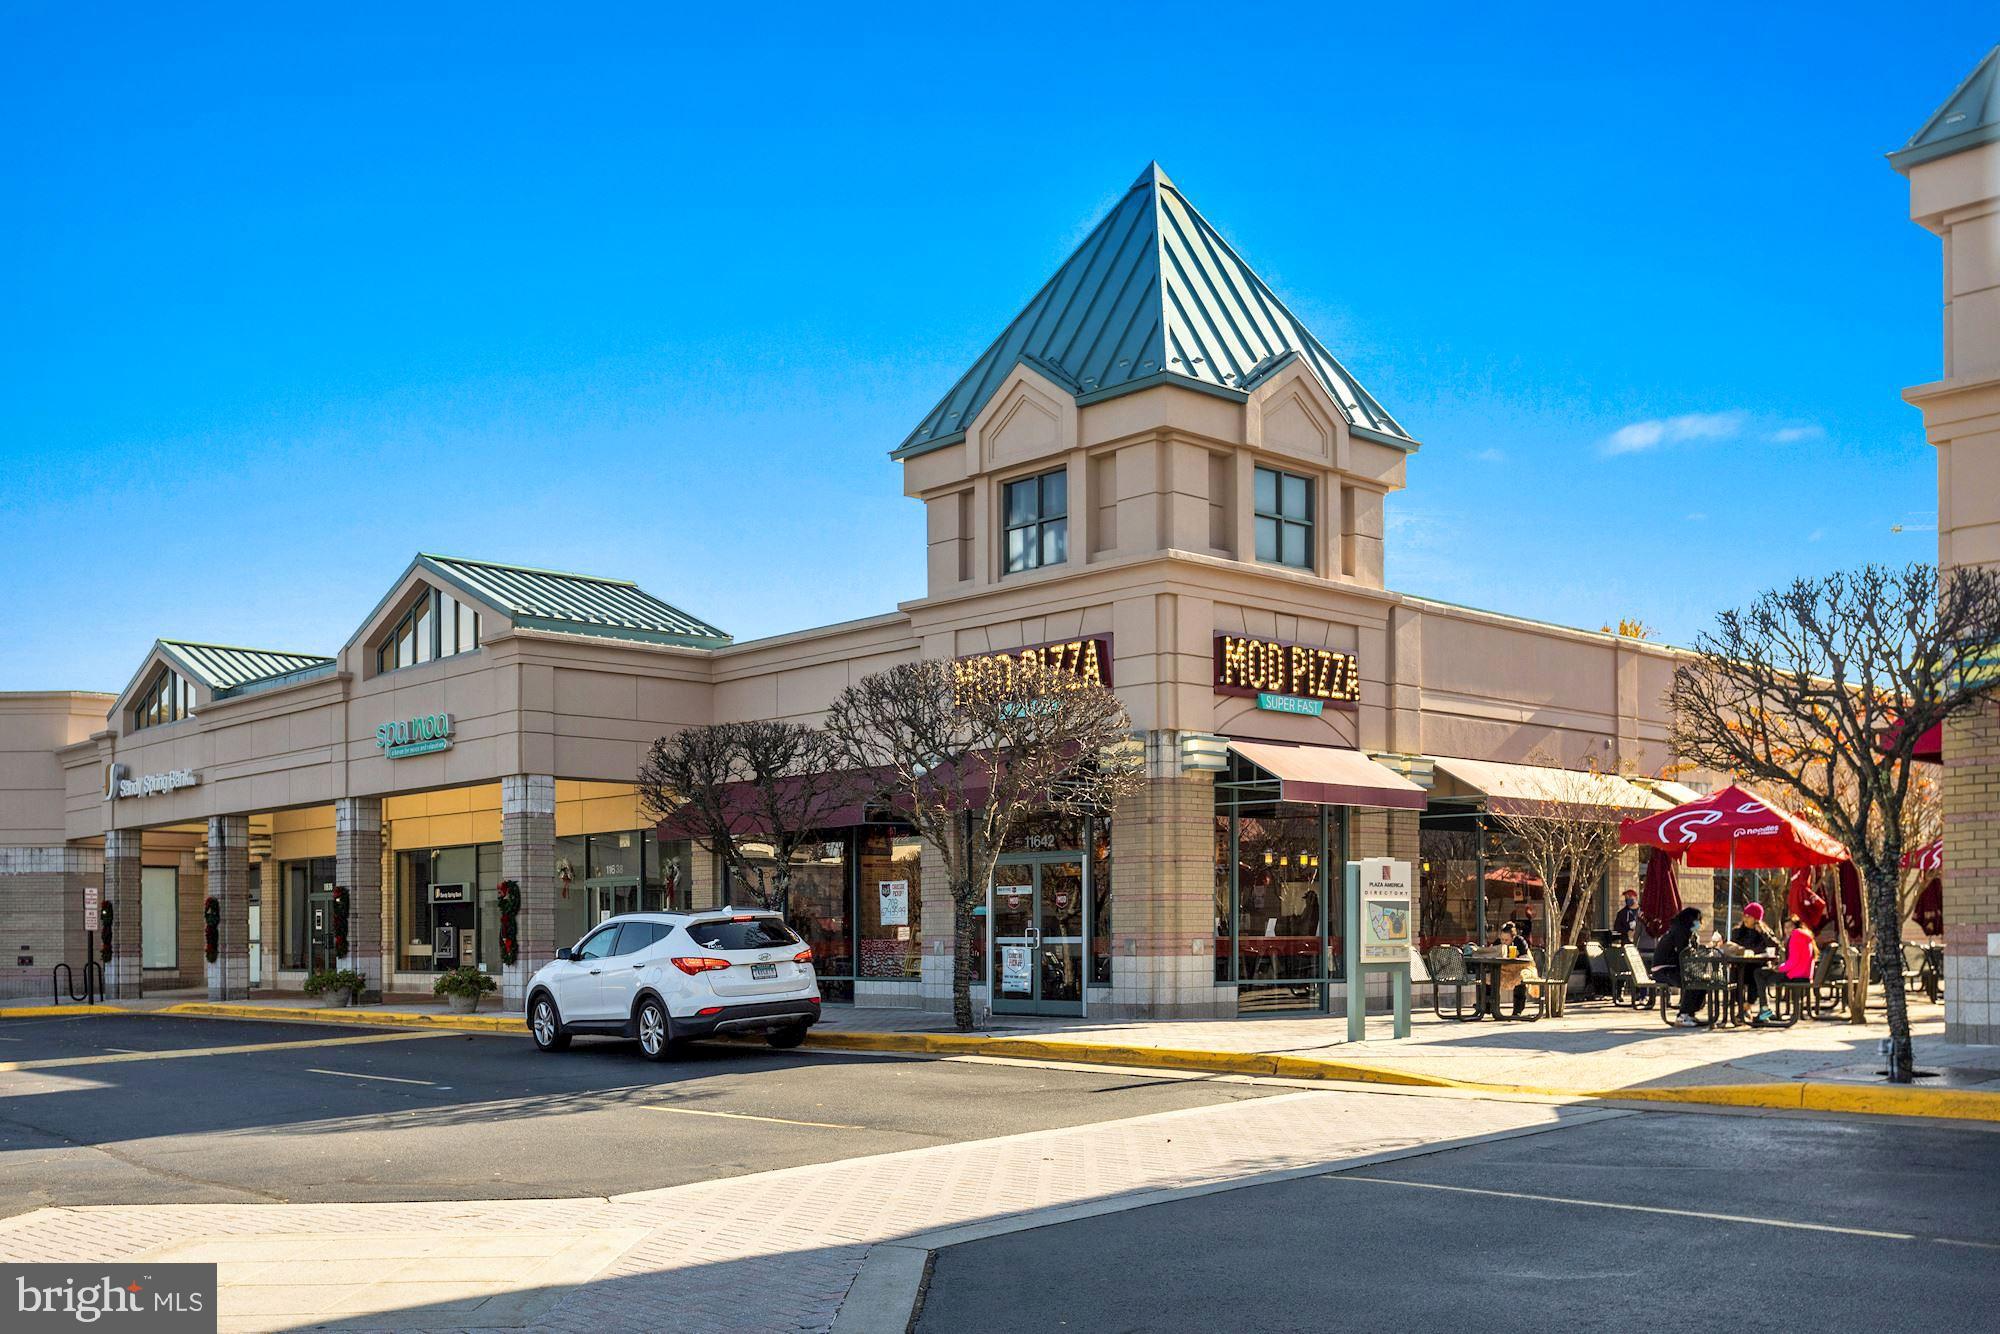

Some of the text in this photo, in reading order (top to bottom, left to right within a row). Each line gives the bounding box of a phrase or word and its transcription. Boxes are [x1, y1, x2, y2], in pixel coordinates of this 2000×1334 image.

[1021, 639, 1101, 697] PIZZA
[1225, 636, 1361, 702] MOD PIZZA
[1265, 696, 1320, 714] SUPER FAST
[375, 712, 449, 760] spa noa
[120, 767, 194, 798] Sandy Spring Bank
[1024, 834, 1055, 848] 11642
[1746, 825, 1779, 835] noodles
